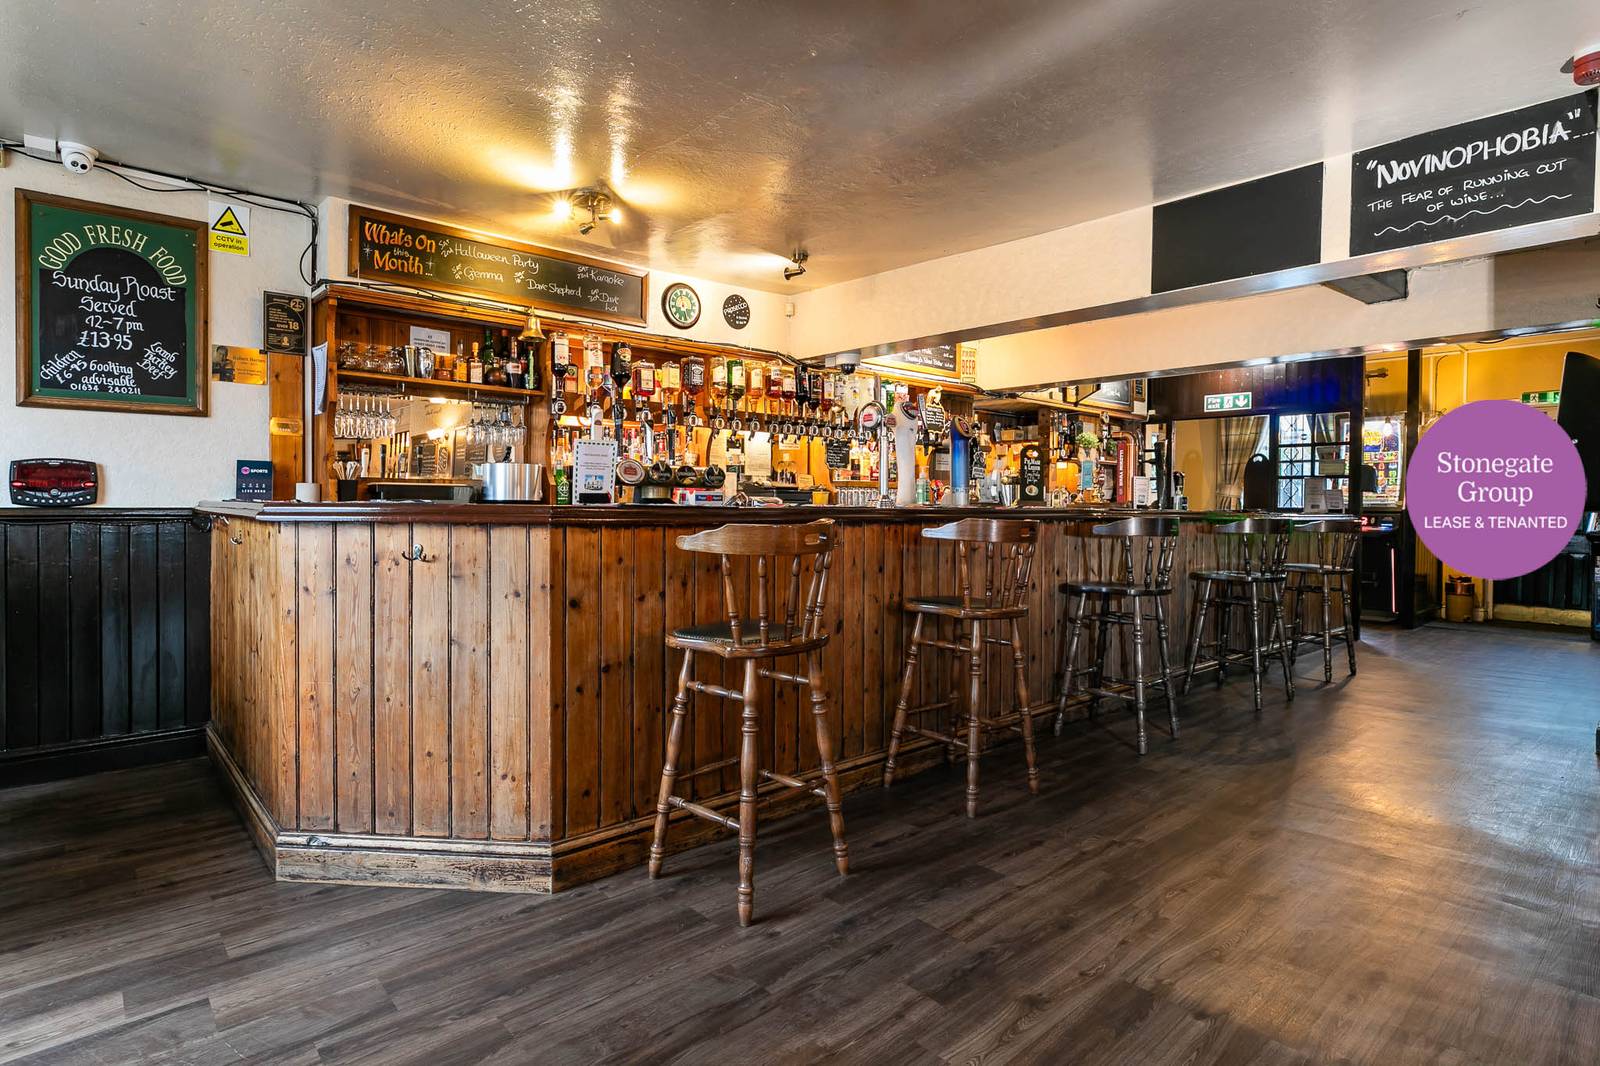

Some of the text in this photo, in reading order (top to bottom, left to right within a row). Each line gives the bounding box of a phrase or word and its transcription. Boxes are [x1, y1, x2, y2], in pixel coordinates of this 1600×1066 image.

[1367, 199, 1393, 213] THE
[1401, 189, 1434, 205] FEAR
[1437, 185, 1454, 196] OF
[1536, 158, 1568, 175] OUT
[1426, 202, 1445, 213] OF
[216, 235, 235, 243] CCTV
[364, 221, 436, 254] Whats On
[38, 224, 188, 286] GOOD FRESH FOOD
[213, 242, 245, 252] operation
[454, 243, 539, 275] Halloween Party
[463, 265, 504, 282] Gemma
[589, 269, 625, 287] Karaoke
[52, 270, 177, 303] Sunday Roast
[78, 296, 137, 318] Served
[291, 299, 304, 310] 25
[126, 321, 145, 334] pm
[288, 320, 300, 331] 18
[150, 341, 180, 363] Lamb
[136, 358, 165, 381] Beef
[143, 348, 178, 380] Turkey
[961, 359, 976, 376] BEER
[81, 372, 137, 388] advisable
